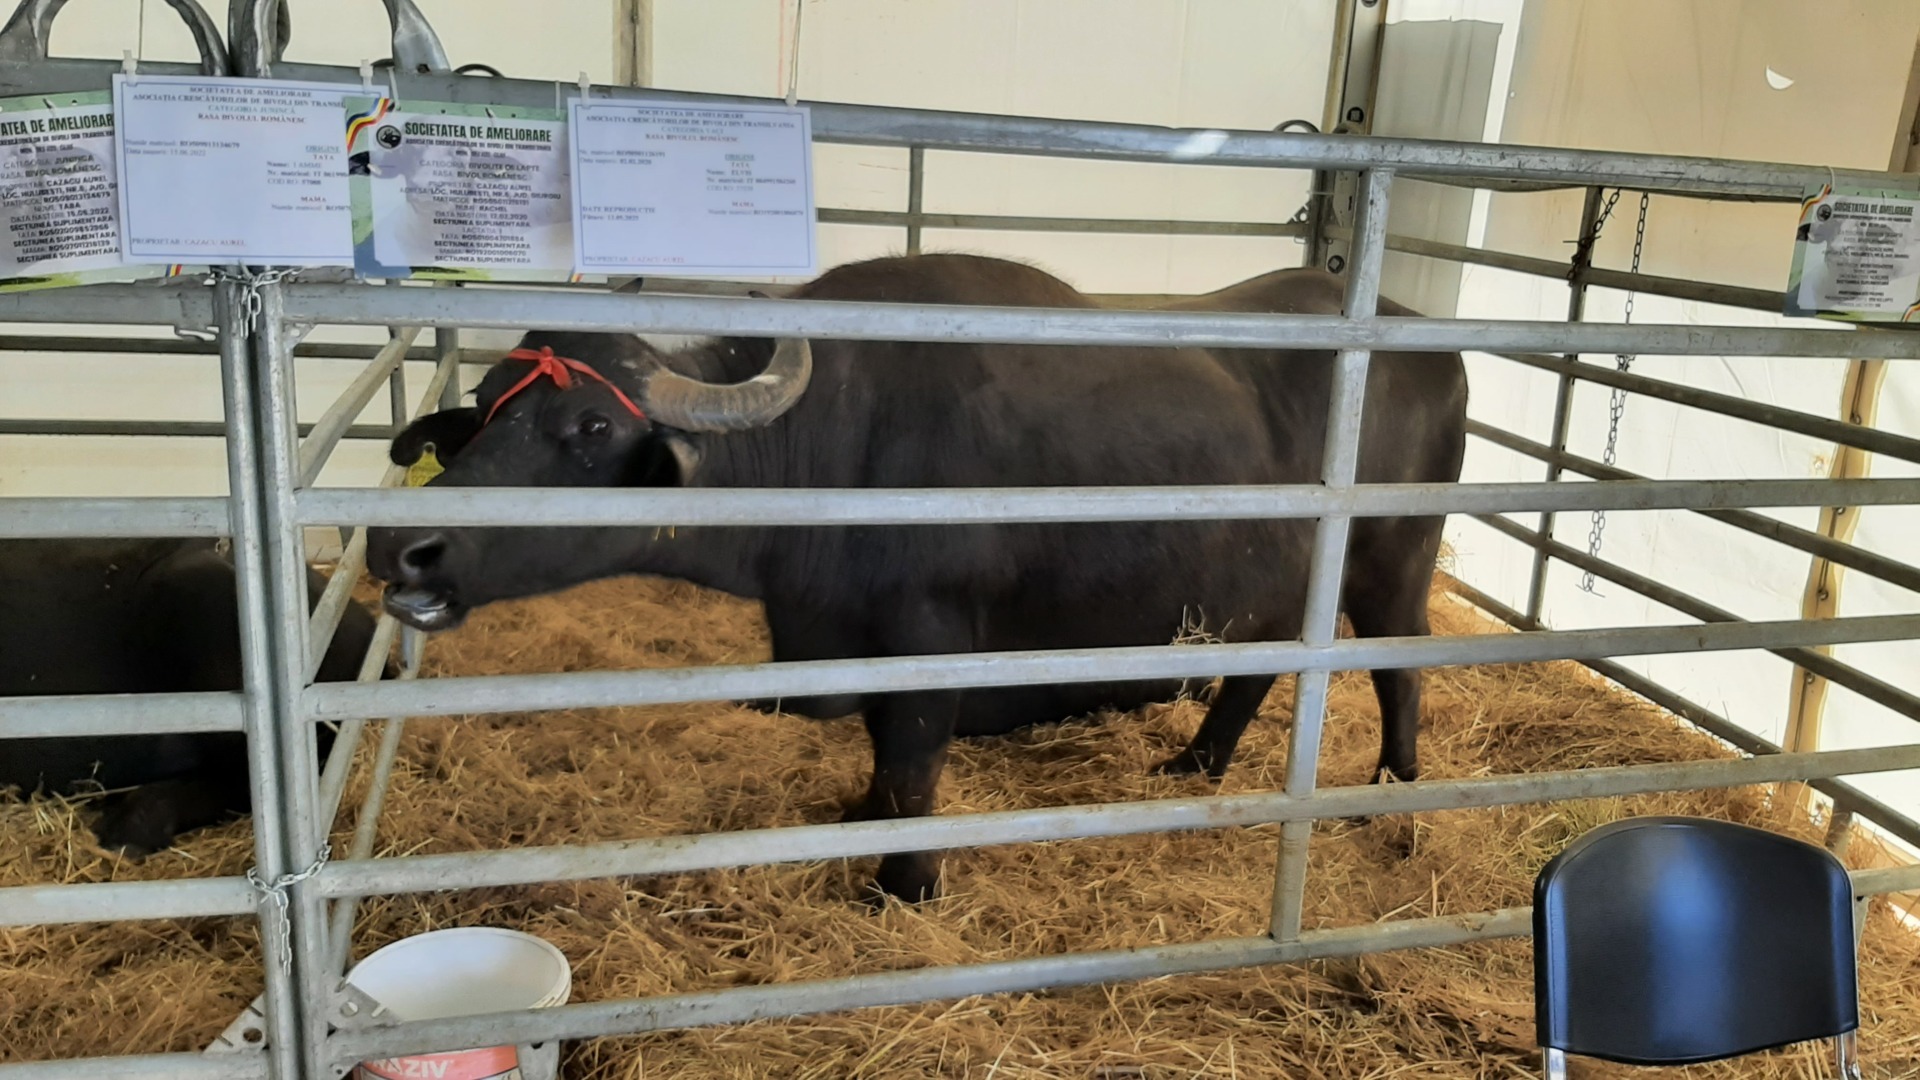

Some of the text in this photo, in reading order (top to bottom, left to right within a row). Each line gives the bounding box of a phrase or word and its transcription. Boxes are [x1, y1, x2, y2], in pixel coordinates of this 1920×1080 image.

[244, 88, 254, 96] DE
[30, 119, 46, 134] DE
[405, 122, 552, 142] SOCIETATEA DE AMELIORARE
